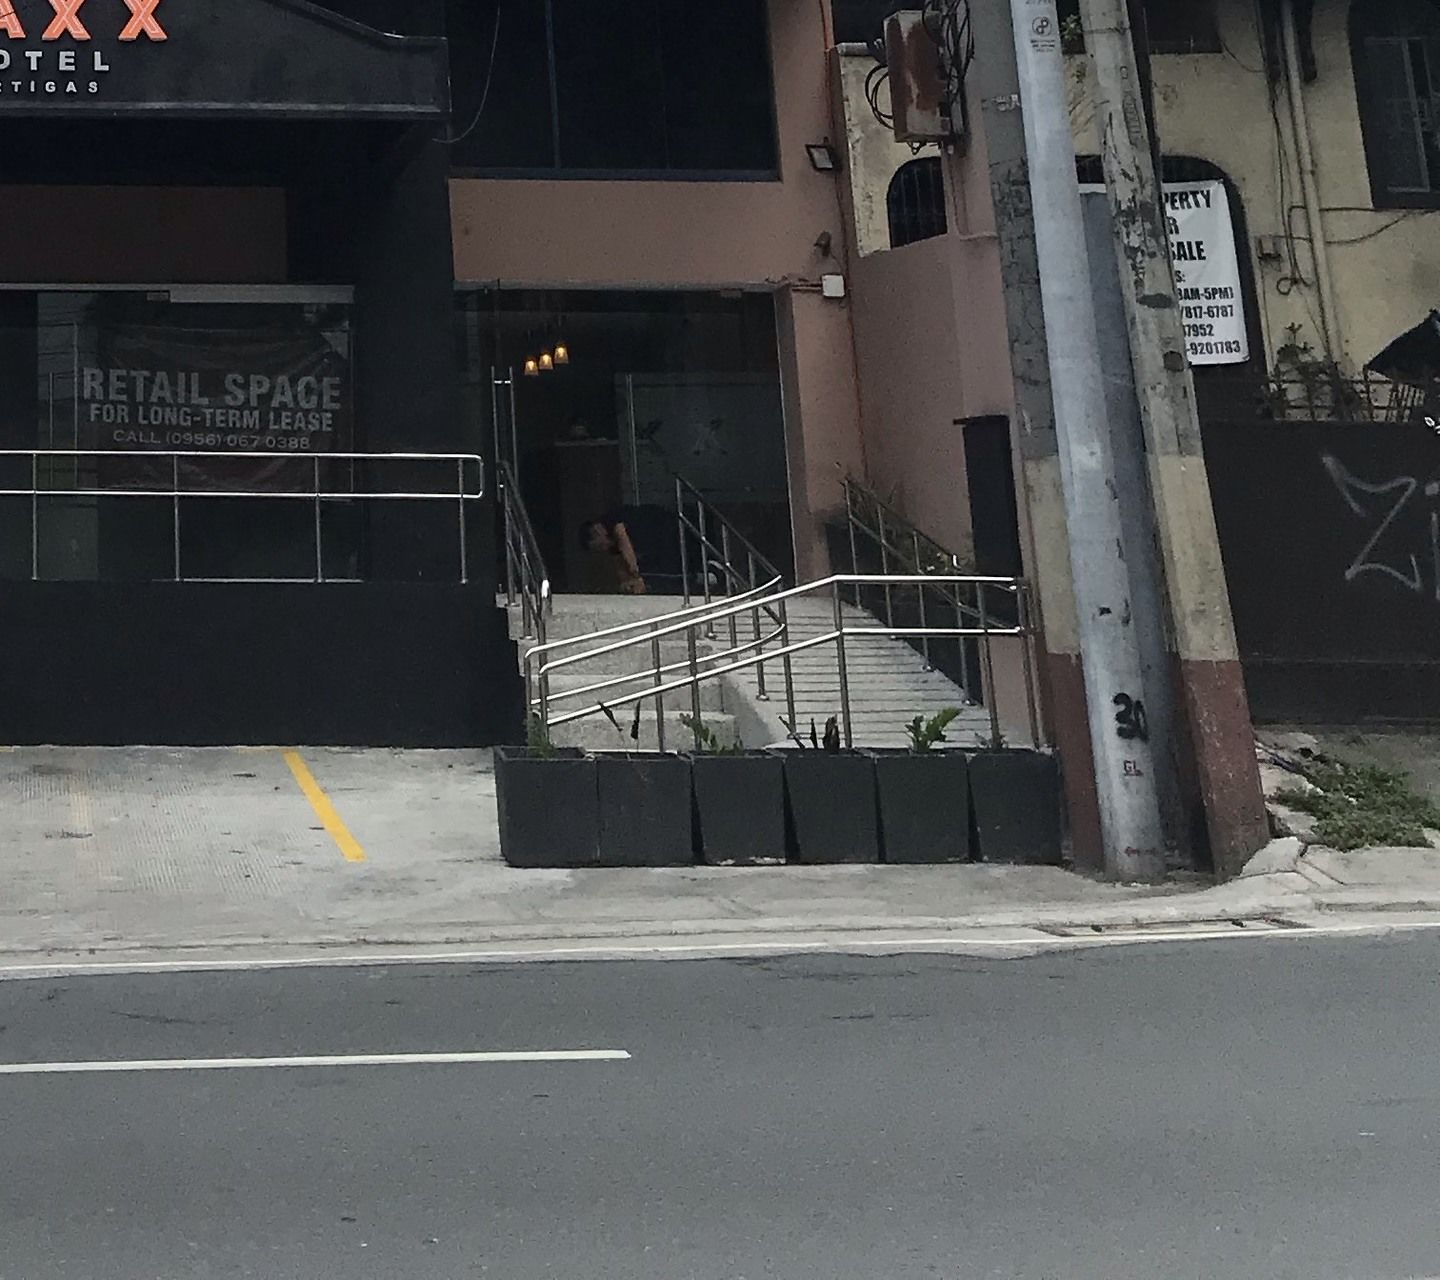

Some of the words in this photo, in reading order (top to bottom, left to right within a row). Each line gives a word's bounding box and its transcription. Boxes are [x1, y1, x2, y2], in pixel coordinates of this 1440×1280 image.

[82, 367, 209, 405] RETAIL
[224, 372, 342, 410] SPACE
[90, 403, 129, 424] FOR
[138, 405, 260, 430] LONG-TERM
[268, 411, 333, 432] LEASE
[113, 429, 161, 444] CALL
